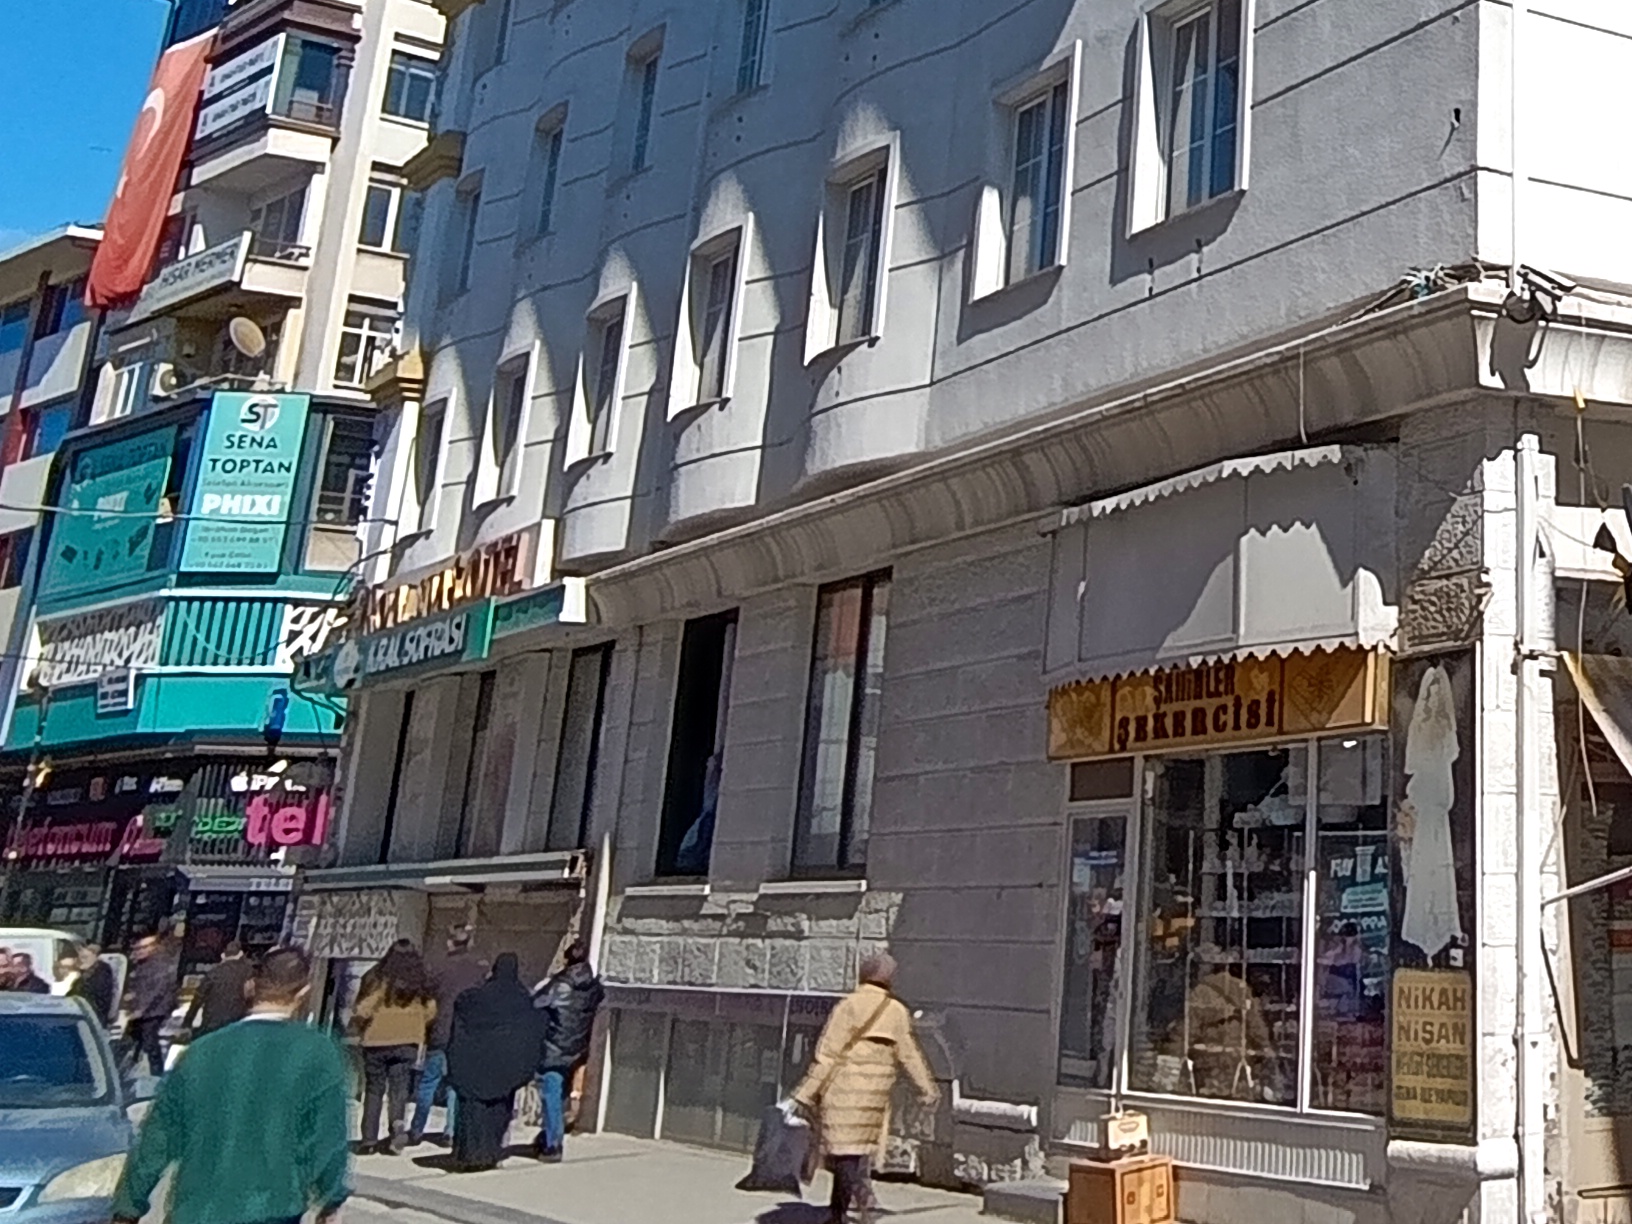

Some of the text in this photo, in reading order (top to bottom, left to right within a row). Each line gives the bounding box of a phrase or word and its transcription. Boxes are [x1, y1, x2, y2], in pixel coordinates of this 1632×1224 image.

[224, 433, 279, 450] SENA
[209, 458, 292, 474] TOPTAN
[201, 493, 281, 515] PHIXI
[1116, 688, 1277, 752] ŞEKERCİSİ
